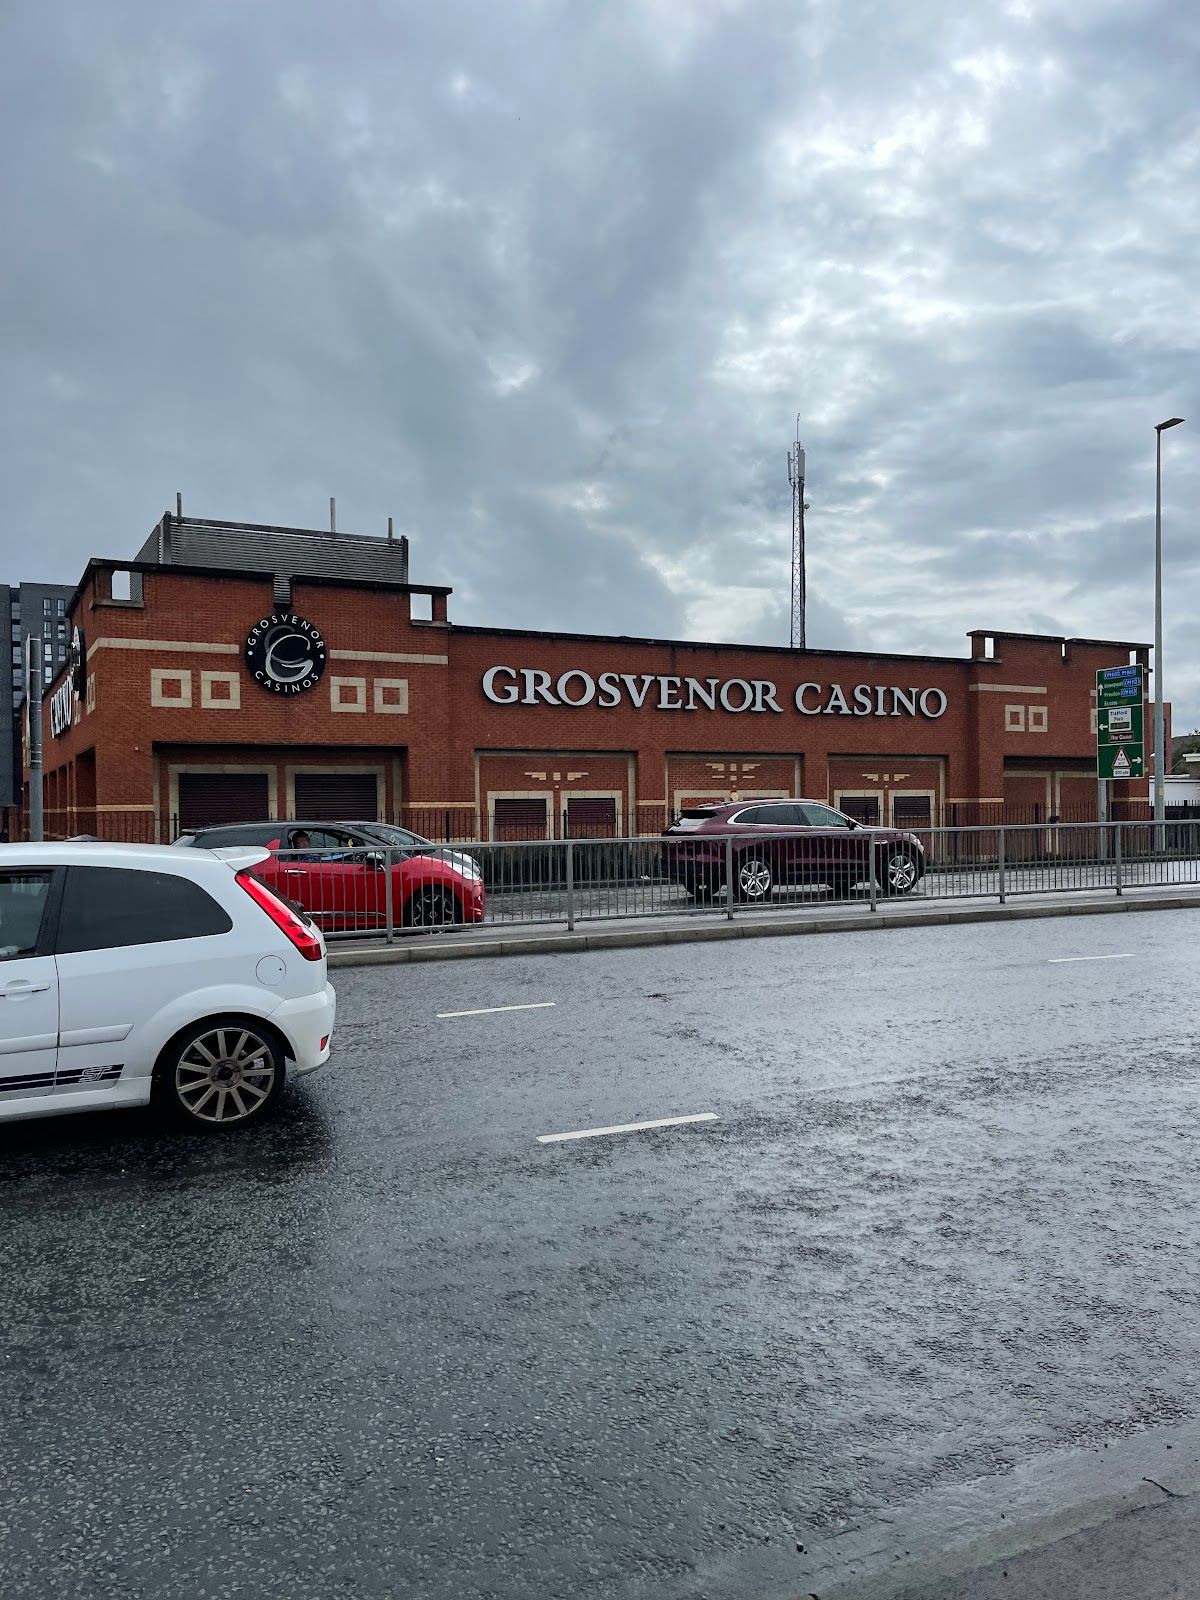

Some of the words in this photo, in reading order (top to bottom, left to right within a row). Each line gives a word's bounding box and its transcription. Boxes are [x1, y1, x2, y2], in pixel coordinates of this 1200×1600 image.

[248, 614, 324, 648] GROSVENOR
[255, 671, 319, 693] CASINOS
[482, 665, 784, 713] GROSVENOR
[795, 683, 948, 718] CASINO
[78, 1065, 113, 1083] ST
